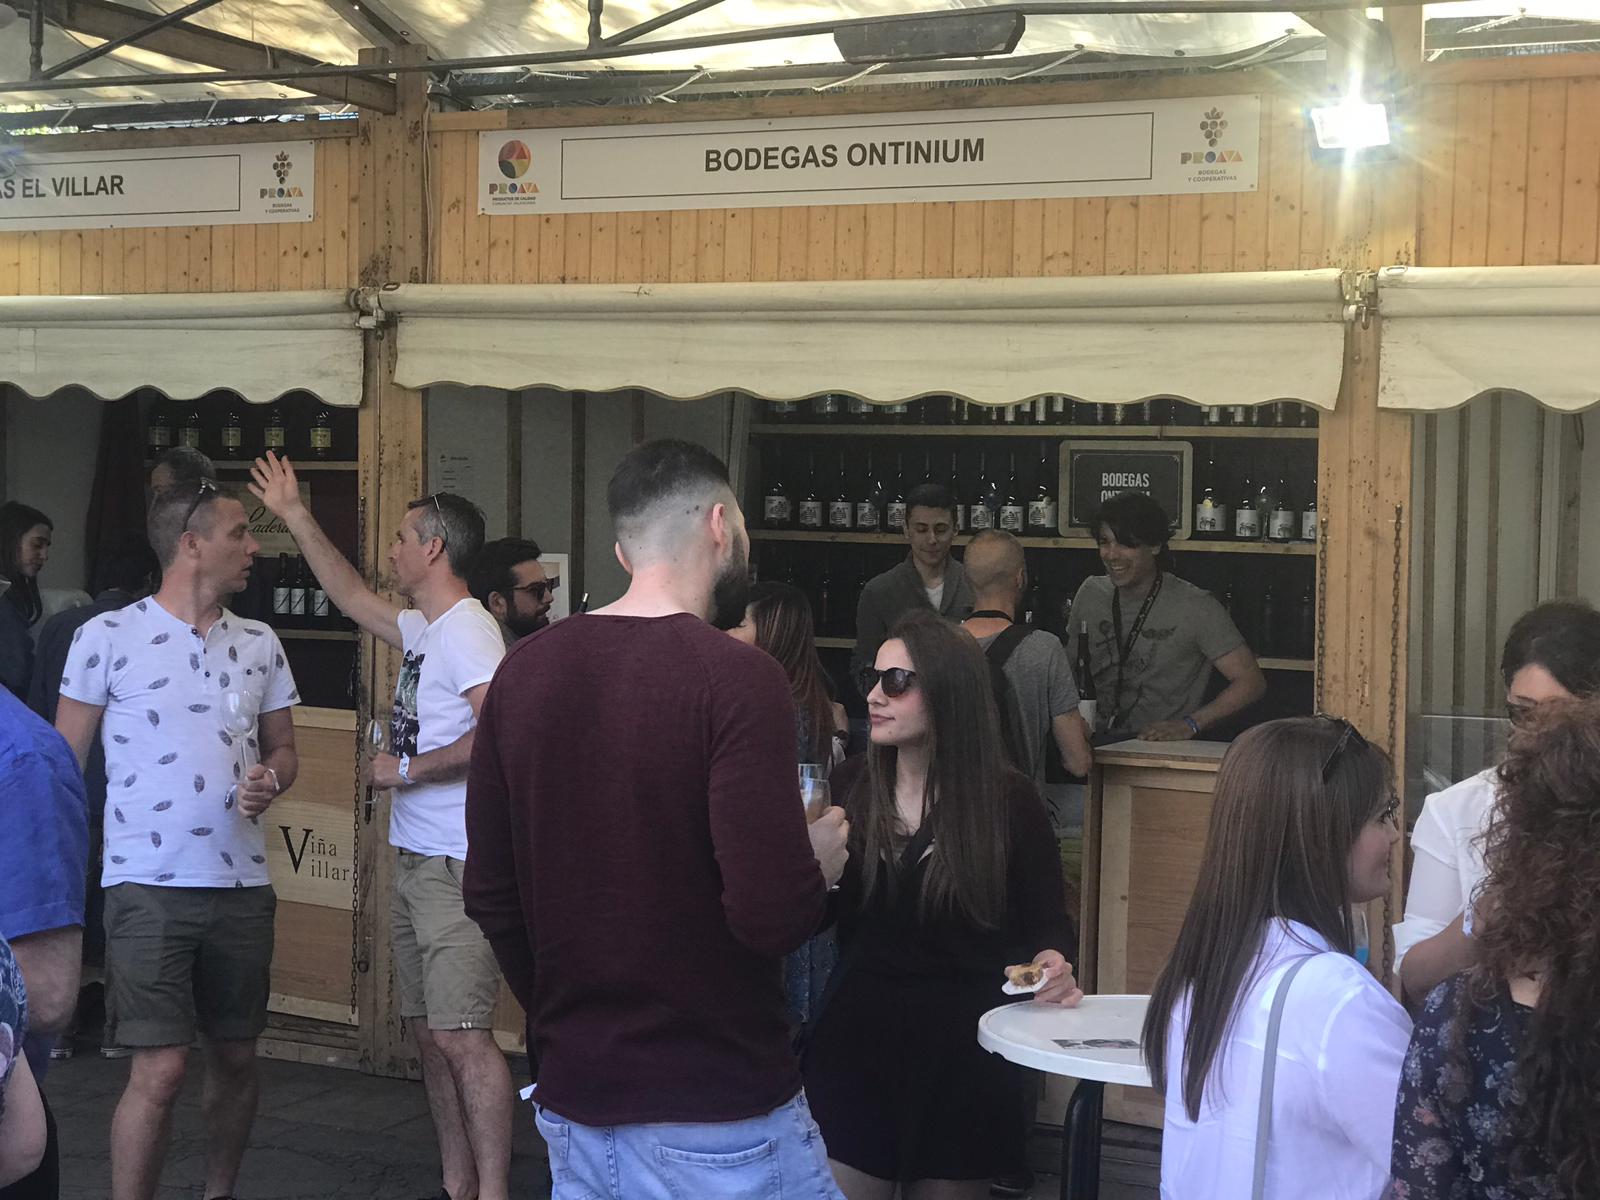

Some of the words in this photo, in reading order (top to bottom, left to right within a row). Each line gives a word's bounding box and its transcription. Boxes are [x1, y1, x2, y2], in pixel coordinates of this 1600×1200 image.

[705, 144, 838, 172] BODEGAS
[847, 138, 985, 166] ONTINIUM
[1180, 150, 1243, 165] PROAVA
[0, 179, 15, 199] S
[22, 178, 46, 198] EL
[52, 175, 125, 198] VILLAR
[260, 187, 304, 199] PROAVA
[488, 182, 540, 195] PROAVA
[1102, 472, 1150, 488] BODEGAS
